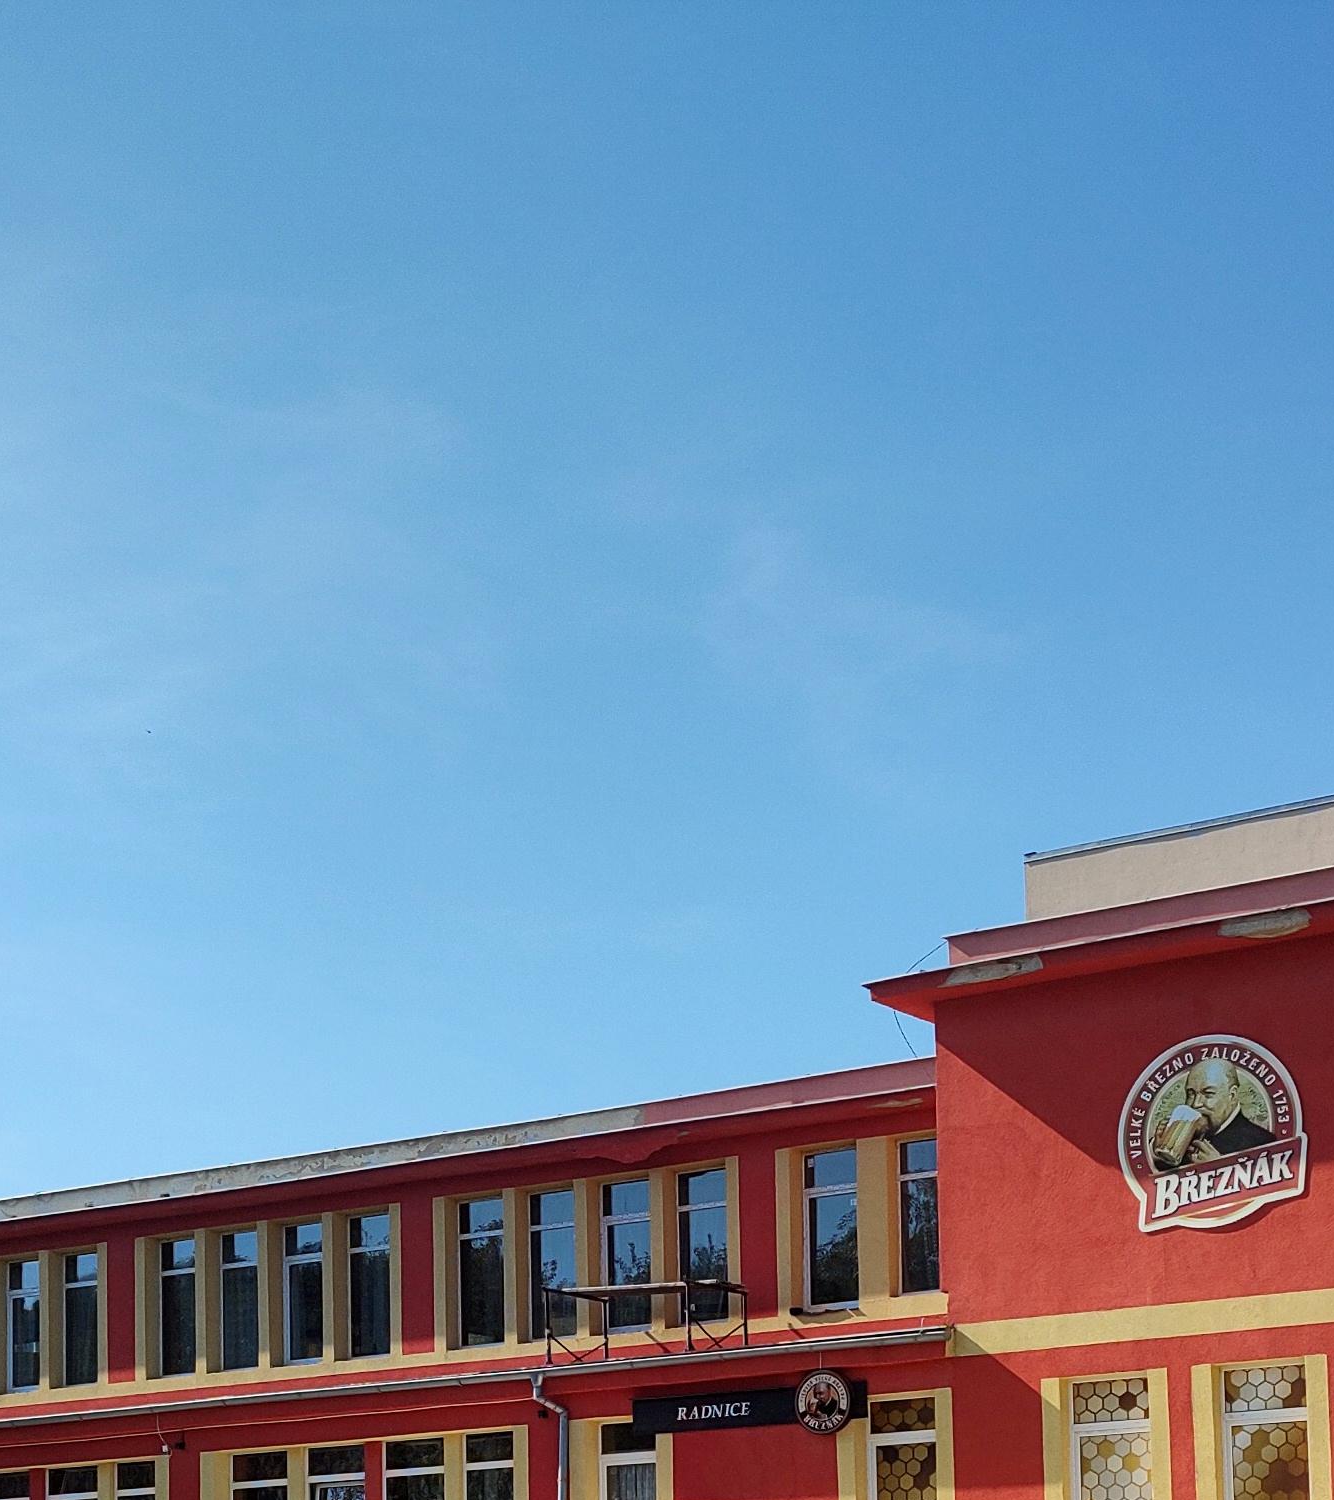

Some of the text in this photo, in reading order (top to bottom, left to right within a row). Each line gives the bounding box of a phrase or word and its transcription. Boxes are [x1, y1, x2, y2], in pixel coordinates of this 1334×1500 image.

[1130, 1107, 1146, 1159] VELKÉ
[1140, 1051, 1195, 1102] BŘEZNO
[1200, 1047, 1276, 1086] ZALOŽENO
[1271, 1089, 1290, 1124] 1753
[1151, 1151, 1294, 1218] BŘEZŇÁK
[676, 1402, 751, 1421] RADNICE
